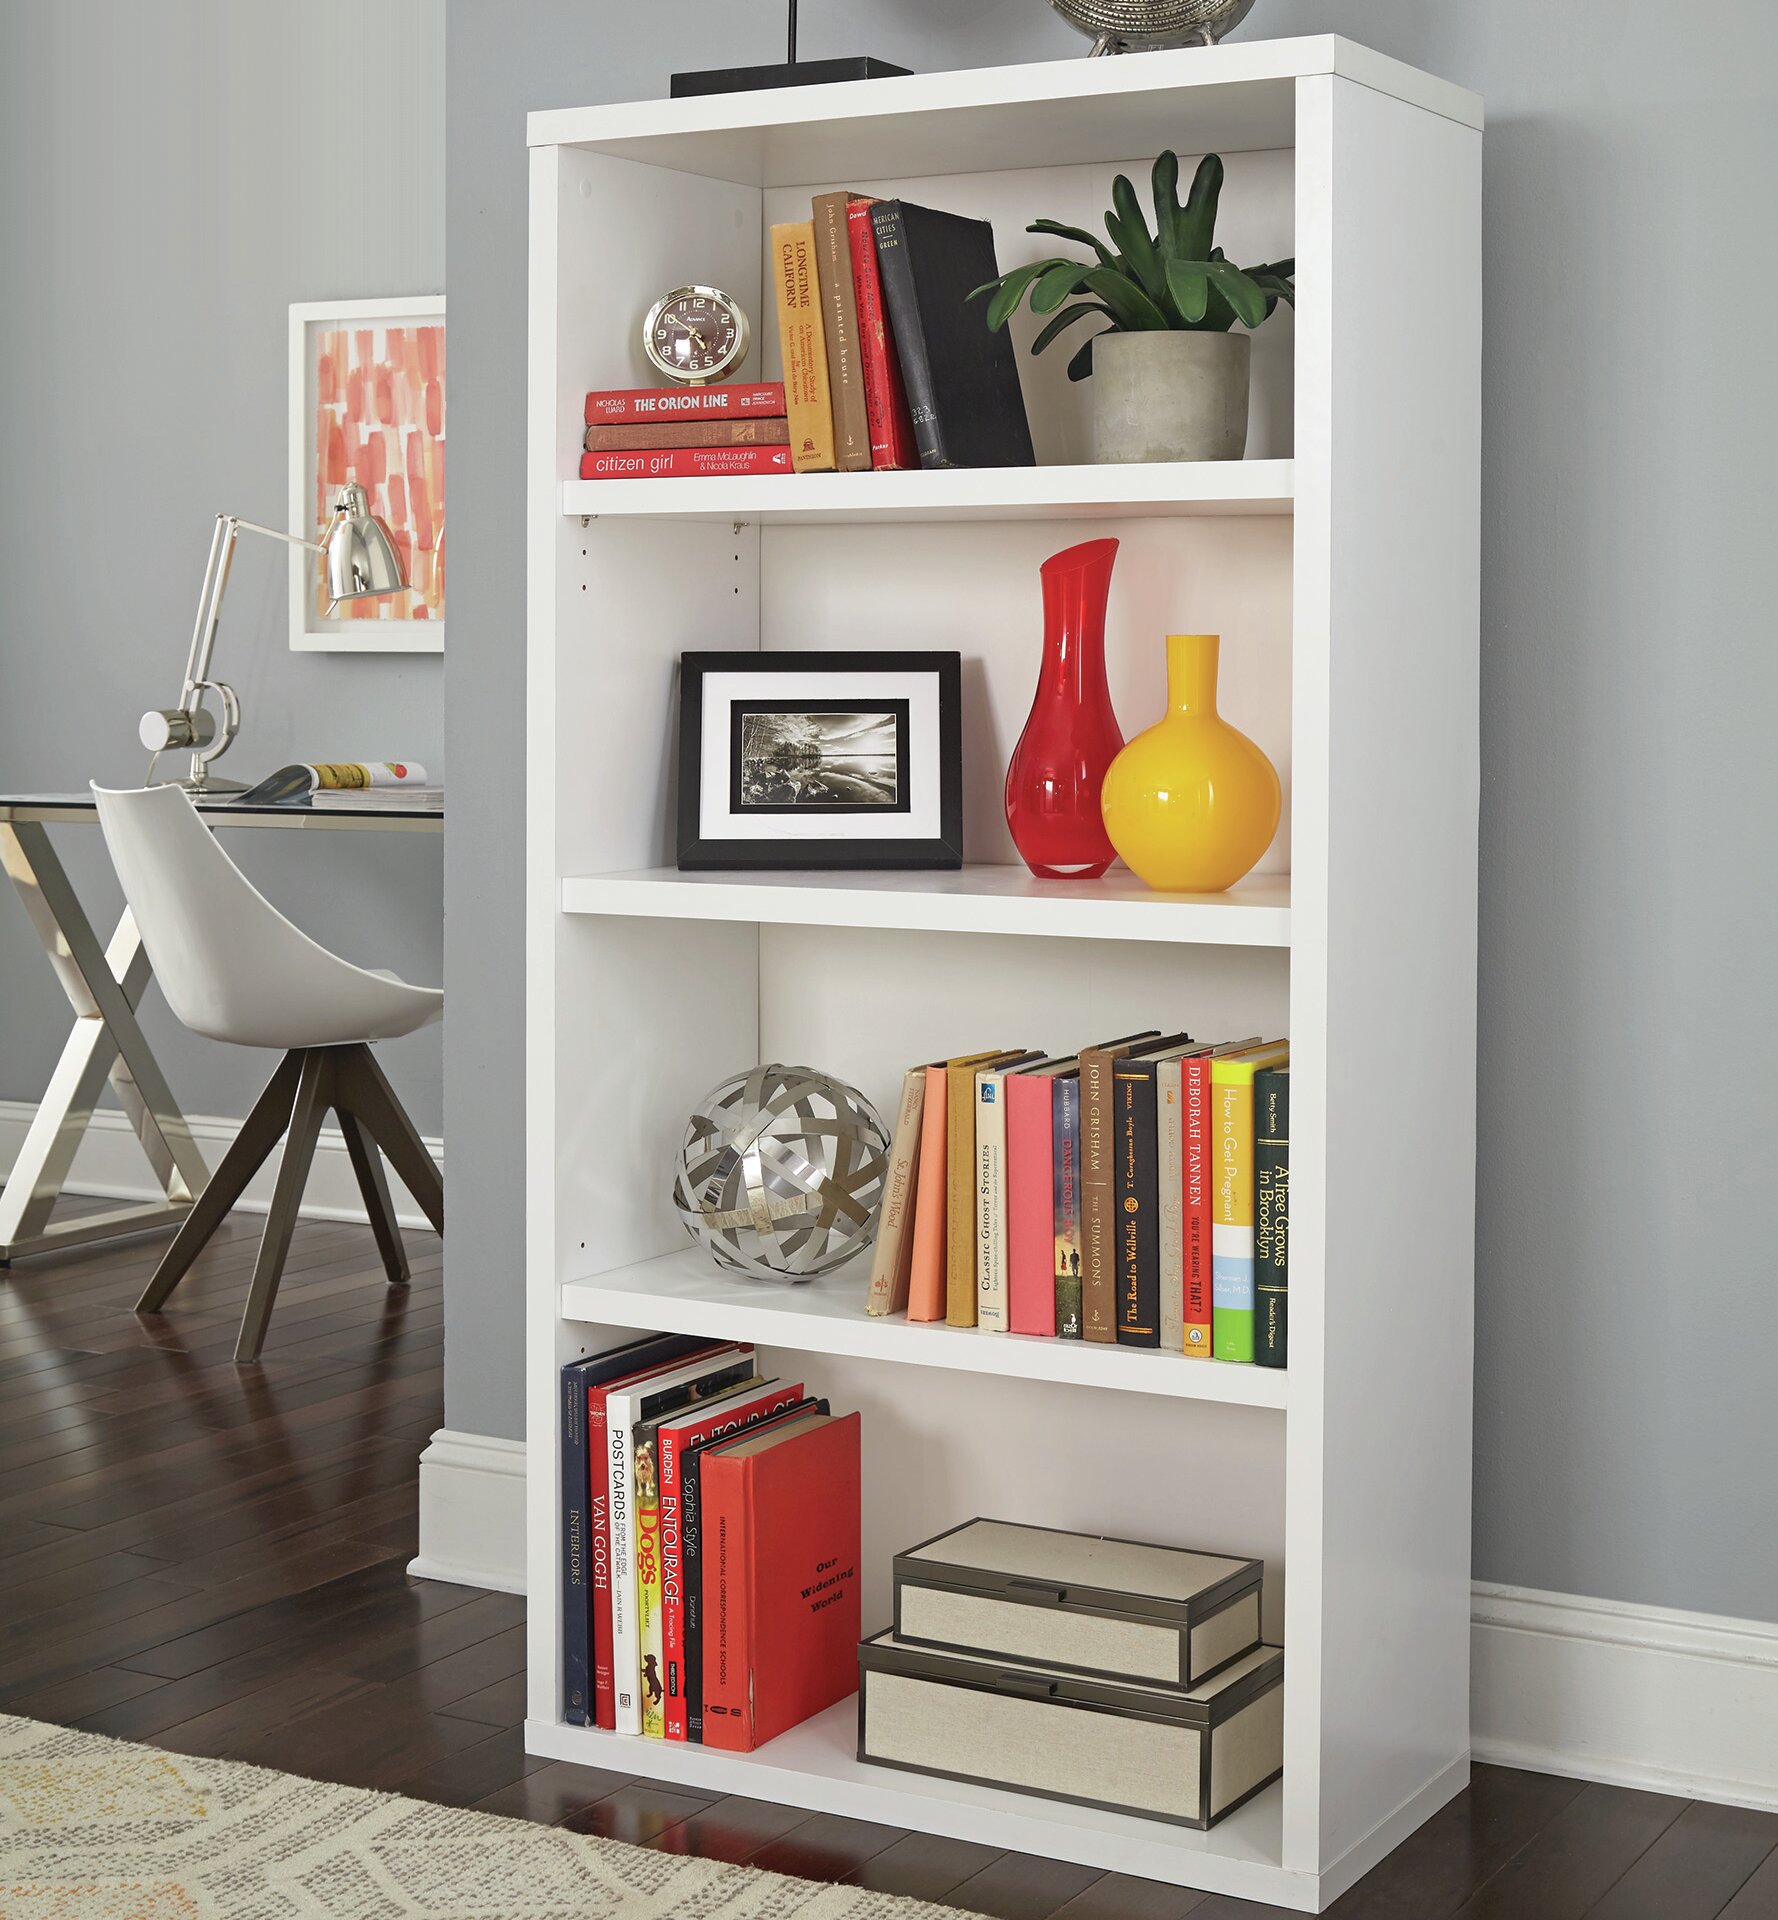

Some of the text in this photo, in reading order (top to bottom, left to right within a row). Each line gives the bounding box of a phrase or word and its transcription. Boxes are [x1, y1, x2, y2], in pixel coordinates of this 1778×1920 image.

[826, 204, 835, 224] John
[873, 212, 900, 225] MERICAN
[876, 224, 896, 235] CITIES
[880, 240, 898, 250] GREEN
[782, 244, 796, 308] CALIFORN'
[796, 241, 810, 308] LONGTIME
[679, 301, 687, 312] 11
[693, 299, 705, 308] 12
[712, 302, 716, 312] 1
[664, 314, 676, 324] 10
[721, 313, 730, 324] 2
[834, 294, 847, 342] painted
[657, 329, 667, 340] 9
[725, 328, 734, 338] 3
[662, 346, 672, 356] 8
[717, 345, 727, 355] 4
[806, 331, 814, 374] Documentary
[676, 356, 685, 367] 7
[689, 360, 699, 370] 6
[704, 356, 714, 367] 5
[840, 349, 848, 384] house
[596, 399, 626, 408] NICHOLAS
[634, 398, 656, 412] THE
[658, 396, 700, 410] ORION
[703, 394, 728, 408] LINE
[912, 405, 930, 416] 323
[596, 454, 674, 474] citizen girl
[694, 452, 756, 462] Emma McLaughlin
[706, 461, 729, 470] Nicola
[730, 460, 750, 470] Kraus
[904, 1088, 914, 1126] FITZGERALD
[912, 1089, 920, 1111] NANCY
[1269, 1093, 1277, 1113] Betty
[1088, 1064, 1100, 1170] JOHN GRISHAM
[1189, 1067, 1201, 1206] DEBORAH TANNEN
[1126, 1117, 1136, 1190] T. Coraghessan Boyle
[1220, 1088, 1238, 1222] How to Get Pregnant
[1062, 1139, 1072, 1215] DANGEROUS
[888, 1159, 908, 1228] St. John's Wood
[981, 1144, 991, 1292] CLASSIC GHOST STORIES
[1256, 1170, 1274, 1259] in Brooklyn
[1275, 1166, 1290, 1266] A Tree Grows
[1092, 1217, 1101, 1286] SUMMONS
[1126, 1220, 1138, 1323] The Road to Wellville
[1190, 1217, 1202, 1312] YOU'RE WEARING THAT?
[663, 1439, 672, 1484] BURDEN
[612, 1430, 626, 1520] POSTCARDS
[682, 1478, 697, 1522] Sophia
[614, 1522, 620, 1530] OF
[570, 1510, 580, 1585] INTERIORS
[594, 1496, 606, 1589] VAN GOGH
[638, 1508, 658, 1585] Dogs
[662, 1496, 678, 1606] ENTOURAGE
[683, 1527, 698, 1557] Style
[816, 1558, 838, 1572] Our
[800, 1566, 854, 1599] Widening
[811, 1590, 842, 1612] World
[704, 1704, 742, 1717] ICS
